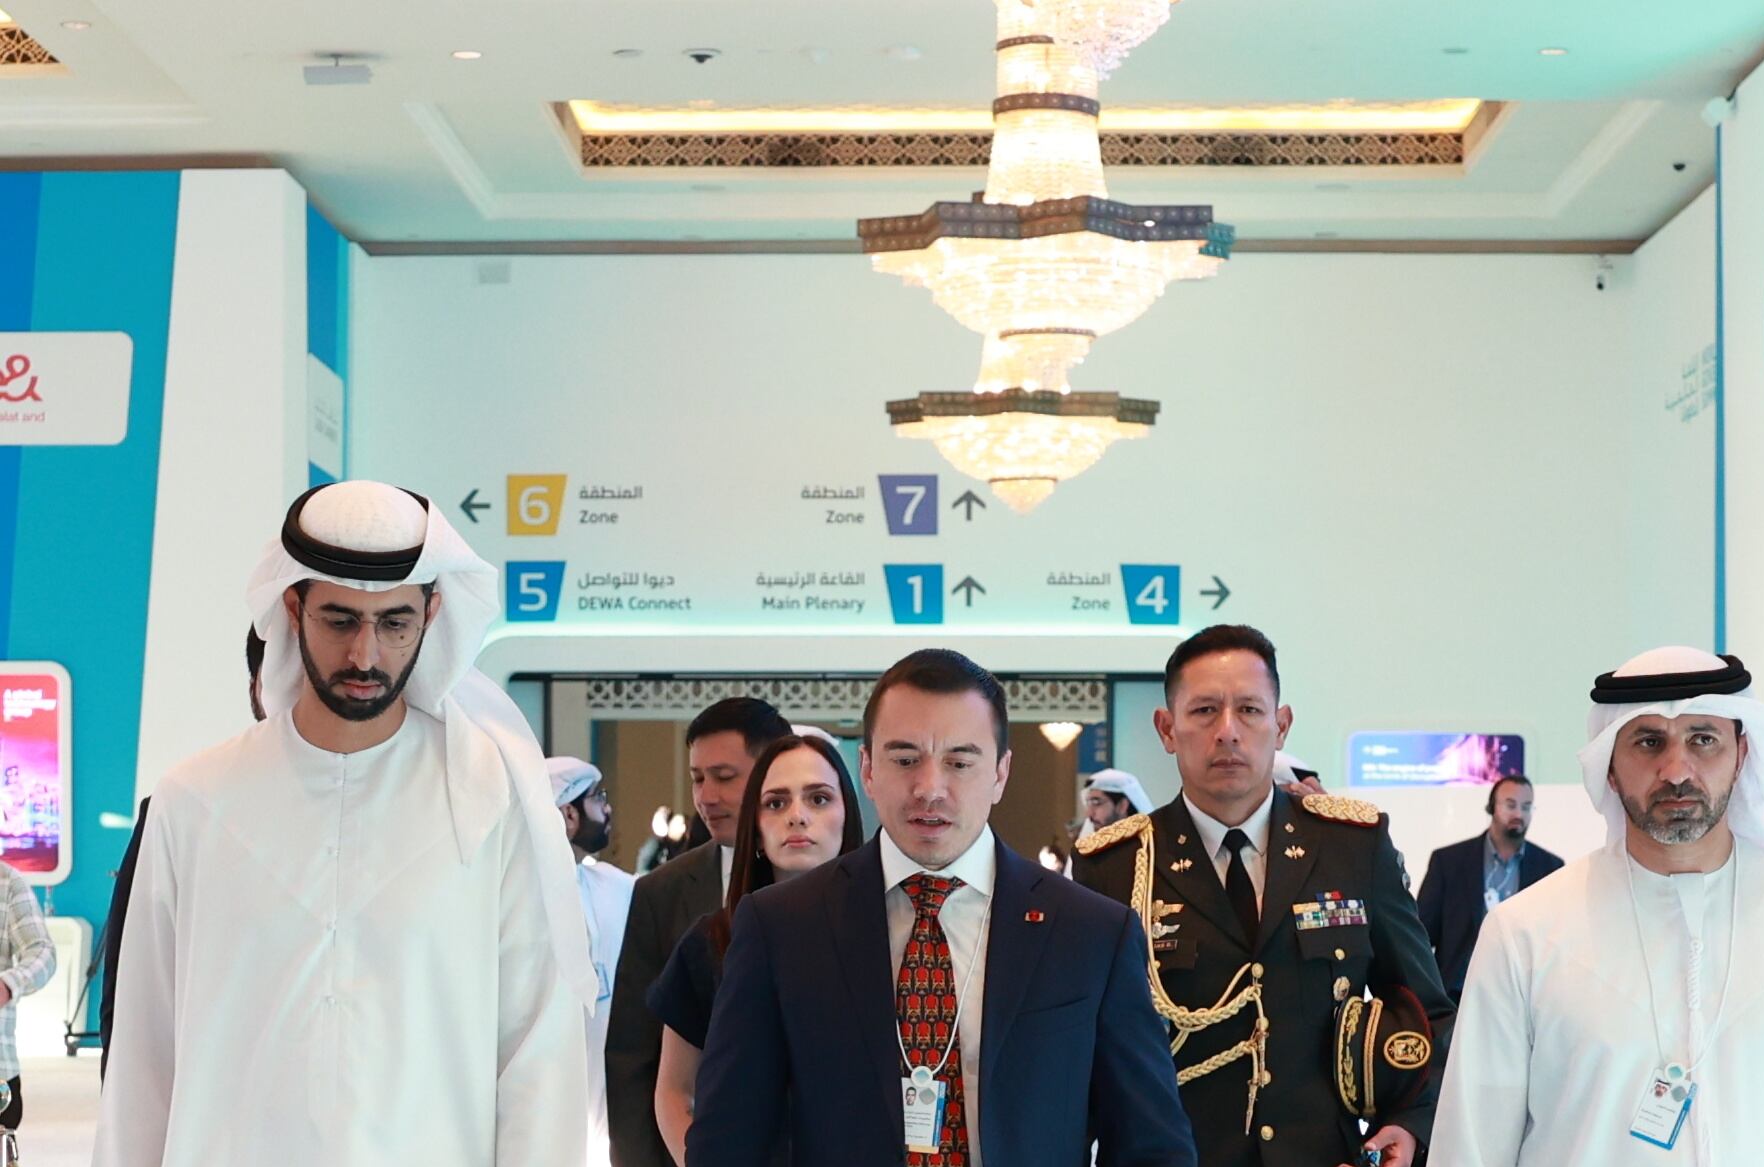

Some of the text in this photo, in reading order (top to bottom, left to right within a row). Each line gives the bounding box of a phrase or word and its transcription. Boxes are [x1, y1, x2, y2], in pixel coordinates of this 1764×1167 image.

[579, 485, 643, 500] المنطقة
[801, 486, 865, 500] المنطقة
[518, 486, 550, 526] 6
[895, 486, 926, 526] 7
[579, 510, 619, 524] Zone
[826, 510, 865, 524] Zone
[578, 573, 675, 590] ديوا للتواصل
[756, 572, 865, 589] القاعة الرئيسية
[1047, 572, 1111, 586] المنطقة
[518, 572, 548, 612] 5
[907, 575, 923, 615] 1
[1135, 575, 1169, 615] 4
[578, 597, 691, 610] DEWA Connect
[762, 597, 865, 613] Main Plenary
[1072, 596, 1111, 610] Zone
